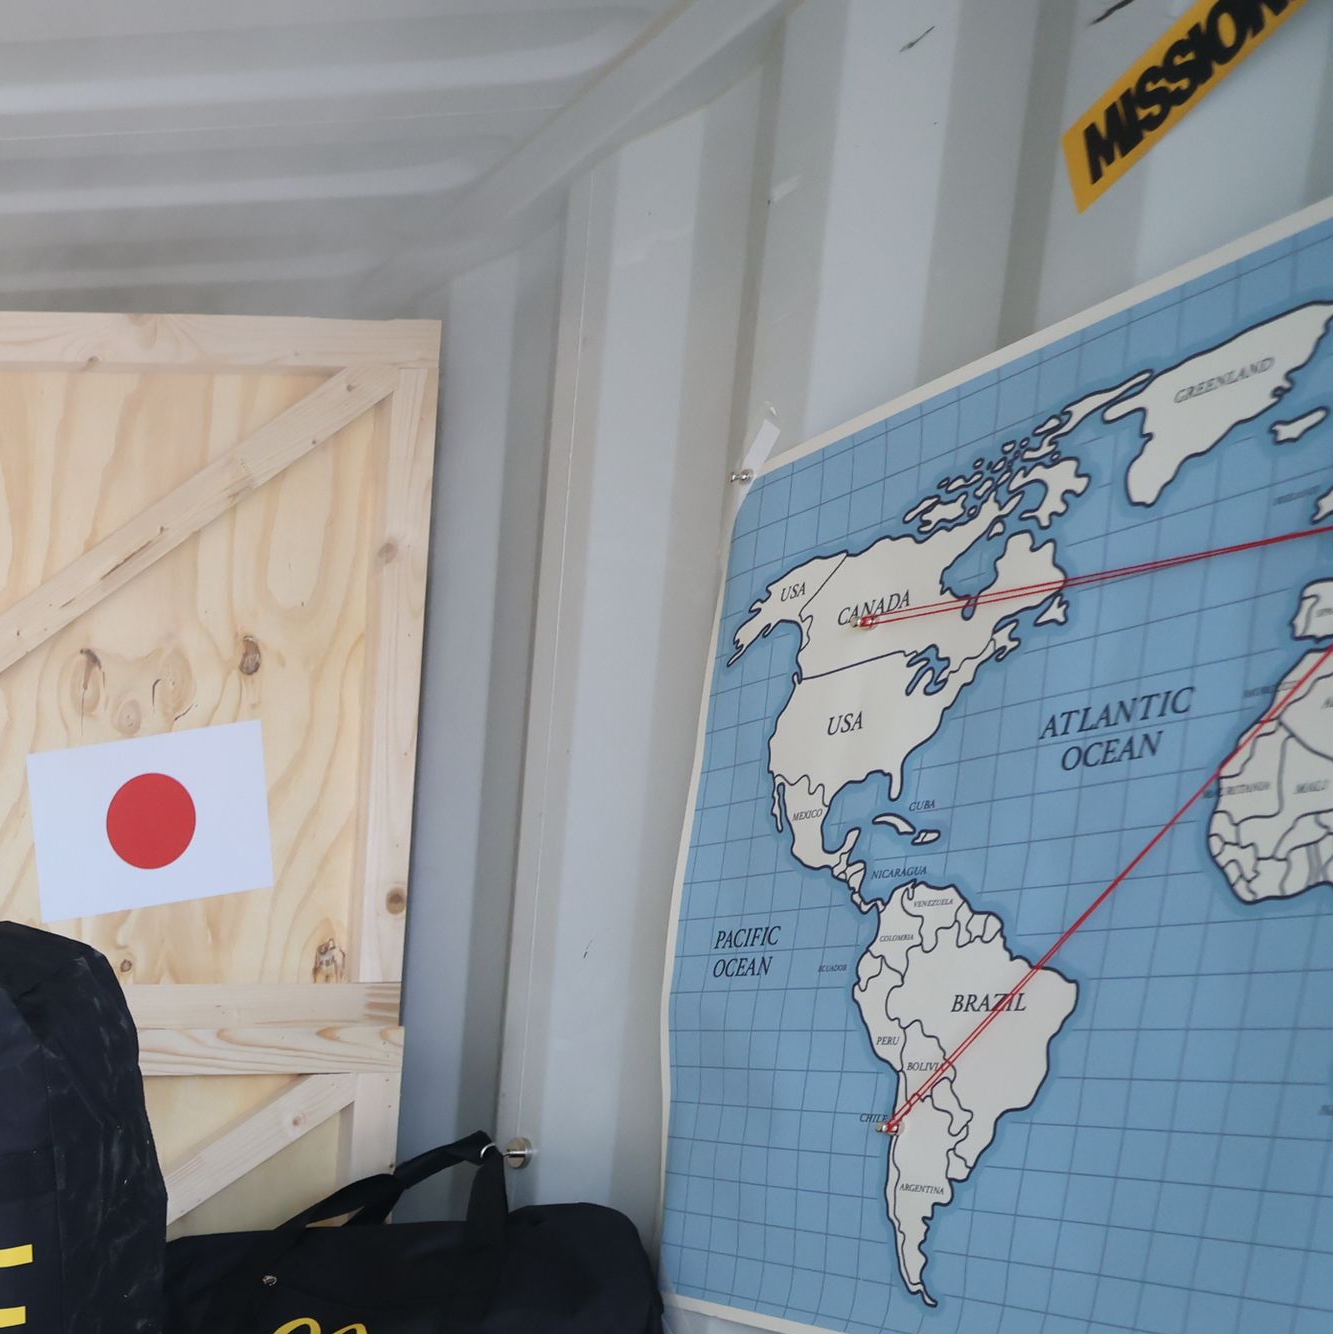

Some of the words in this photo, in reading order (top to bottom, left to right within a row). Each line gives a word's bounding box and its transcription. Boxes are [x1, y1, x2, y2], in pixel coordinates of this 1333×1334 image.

[1173, 357, 1275, 404] GREENLAND
[780, 582, 806, 602] USA
[837, 589, 911, 626] CANADA
[827, 710, 863, 736] USA
[1037, 686, 1196, 740] ATLANTIC
[1060, 731, 1164, 771] OCEAN
[792, 808, 824, 822] MEXICO
[908, 799, 936, 812] CUBA
[870, 866, 928, 880] NICARAGUA
[913, 898, 954, 908] VENEZUELA
[714, 925, 782, 950] PACIFIC
[879, 933, 914, 943] COLOMBIA
[713, 956, 774, 978] OCEAN
[950, 992, 1027, 1013] BRAZIL
[876, 1036, 900, 1046] PERU
[899, 1183, 945, 1195] ARGENTINA
